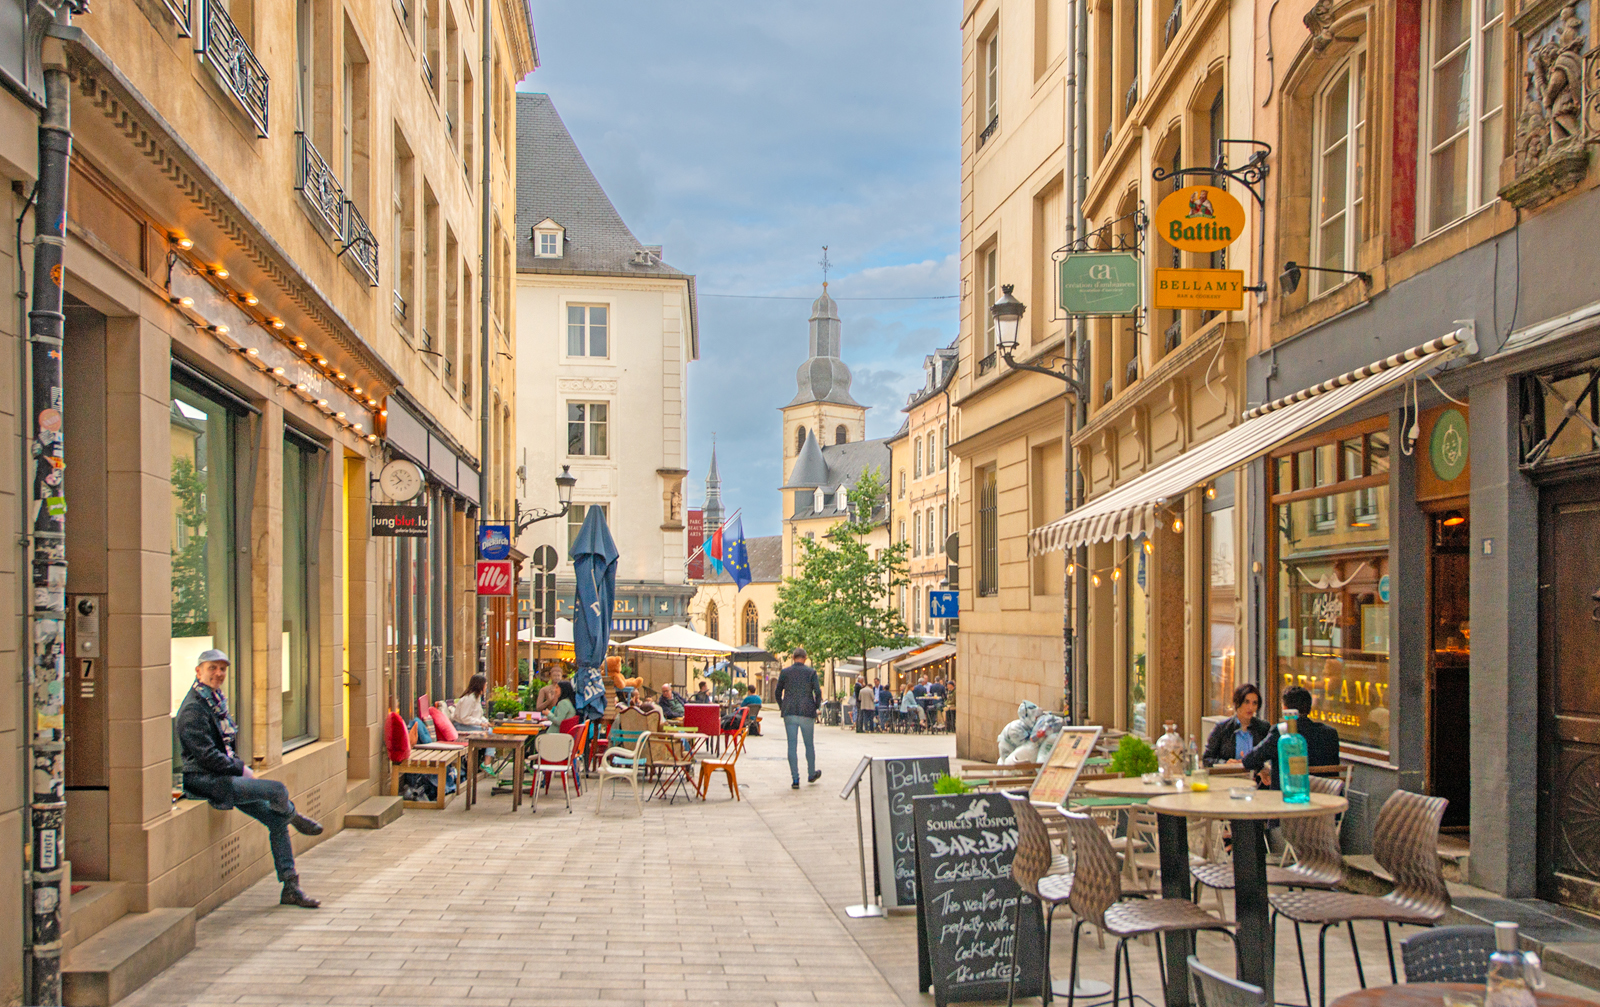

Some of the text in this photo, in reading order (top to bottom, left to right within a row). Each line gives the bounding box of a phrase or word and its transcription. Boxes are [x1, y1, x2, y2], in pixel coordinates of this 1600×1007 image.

[1169, 219, 1232, 241] Battin
[1089, 264, 1112, 280] ca
[1160, 280, 1239, 291] BELLAMY
[372, 515, 428, 528] jungblut.lu
[479, 566, 509, 592] illy
[83, 660, 92, 678] 7
[887, 760, 943, 790] Bellam
[926, 814, 1017, 831] SOURCES ROSPOR
